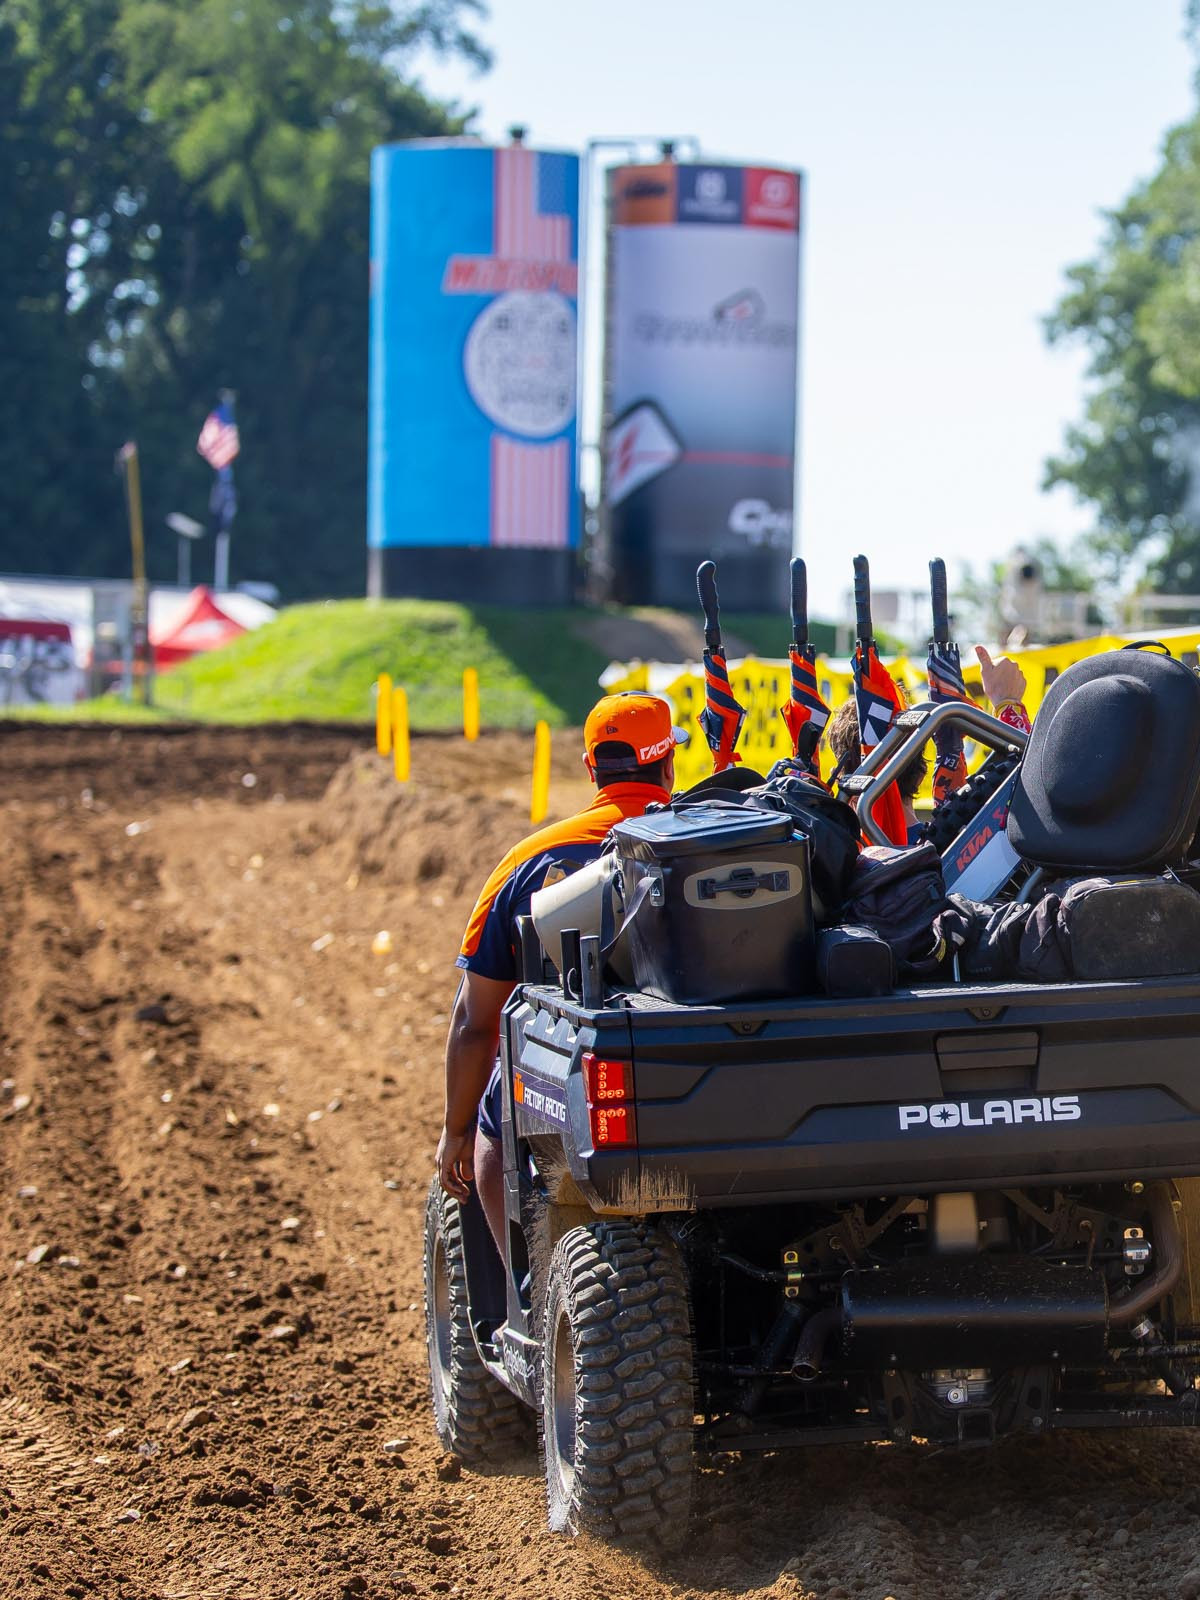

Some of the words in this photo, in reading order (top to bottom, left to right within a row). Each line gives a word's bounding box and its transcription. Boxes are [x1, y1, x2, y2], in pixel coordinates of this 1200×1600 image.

[640, 729, 675, 760] RACIN
[956, 825, 993, 872] KTM
[524, 1086, 547, 1112] FACTORY
[545, 1096, 566, 1123] RACING
[899, 1096, 1081, 1130] POLARIS
